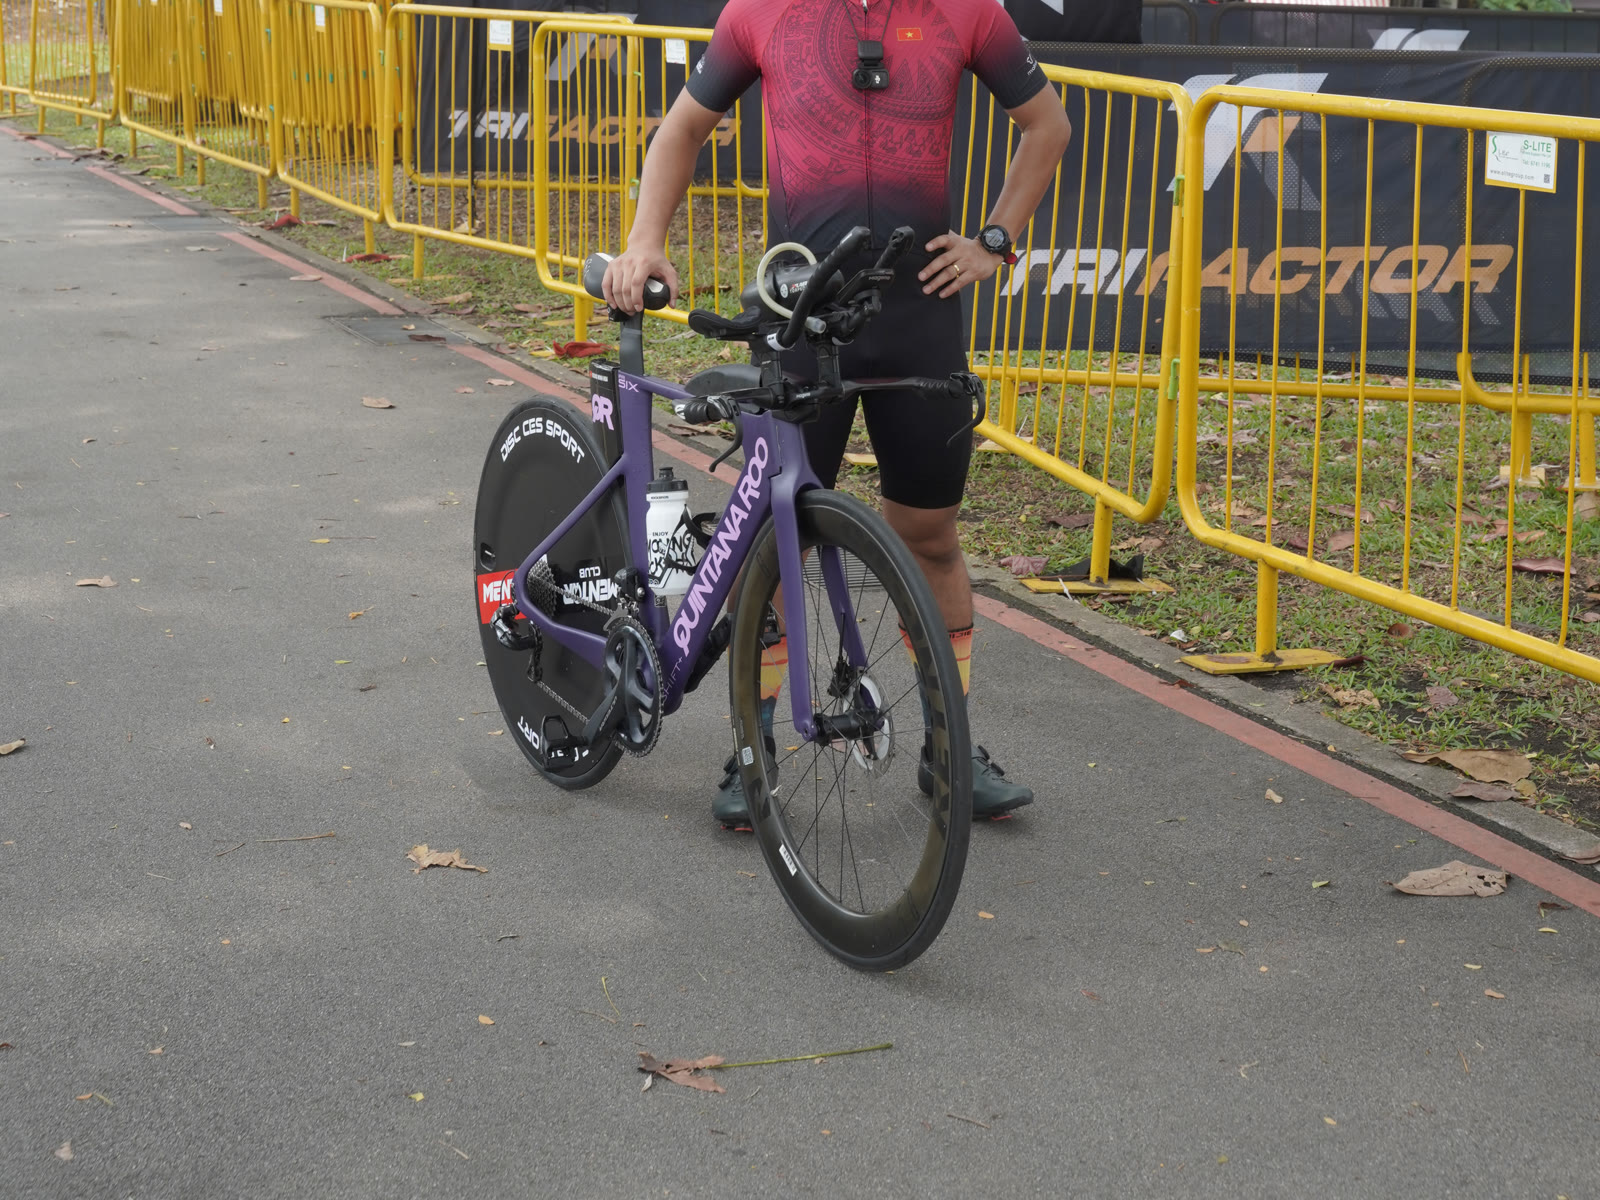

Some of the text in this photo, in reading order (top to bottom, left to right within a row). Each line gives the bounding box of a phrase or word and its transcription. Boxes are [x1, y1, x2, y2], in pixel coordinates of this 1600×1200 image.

[1523, 140, 1552, 152] S-LITE
[618, 379, 640, 393] SIX
[592, 394, 615, 431] QR
[500, 417, 585, 464] DISC CES SPORT
[578, 565, 601, 579] CLUB
[482, 578, 515, 604] MEN
[517, 715, 540, 750] ORT
